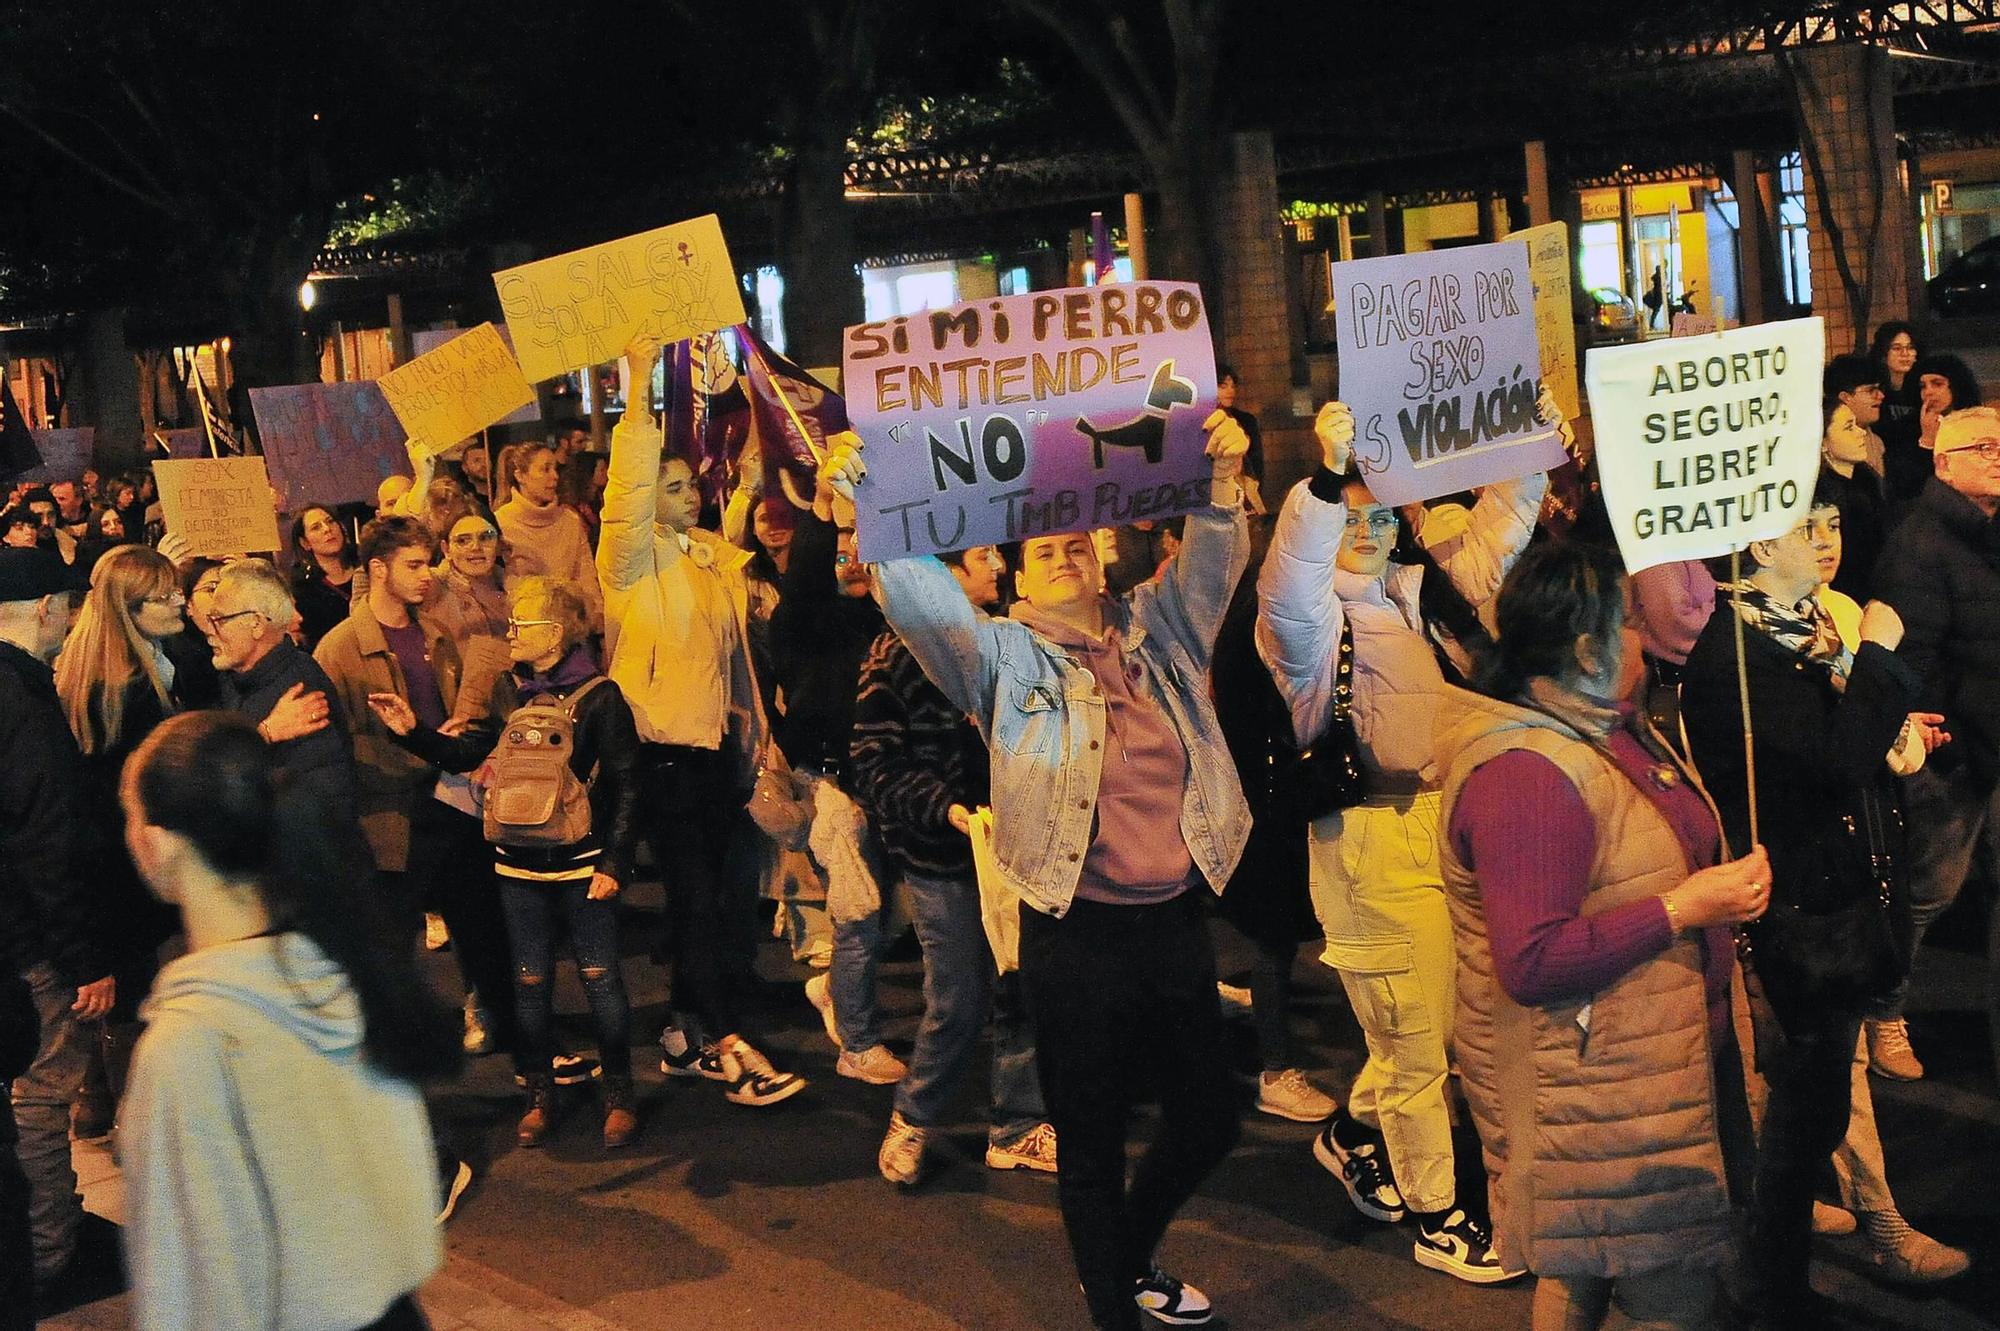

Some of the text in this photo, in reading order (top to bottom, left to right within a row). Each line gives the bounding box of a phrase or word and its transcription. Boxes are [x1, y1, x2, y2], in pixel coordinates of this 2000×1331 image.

[1936, 184, 1950, 208] P
[532, 286, 630, 348] SOLA
[1033, 284, 1202, 342] PERRO
[1352, 273, 1466, 349] PAGAR
[1474, 267, 1519, 323] POR
[1403, 335, 1485, 401] SEXO
[1650, 346, 1786, 397] ABORTO
[1350, 413, 1392, 476] S
[879, 498, 966, 553] TU
